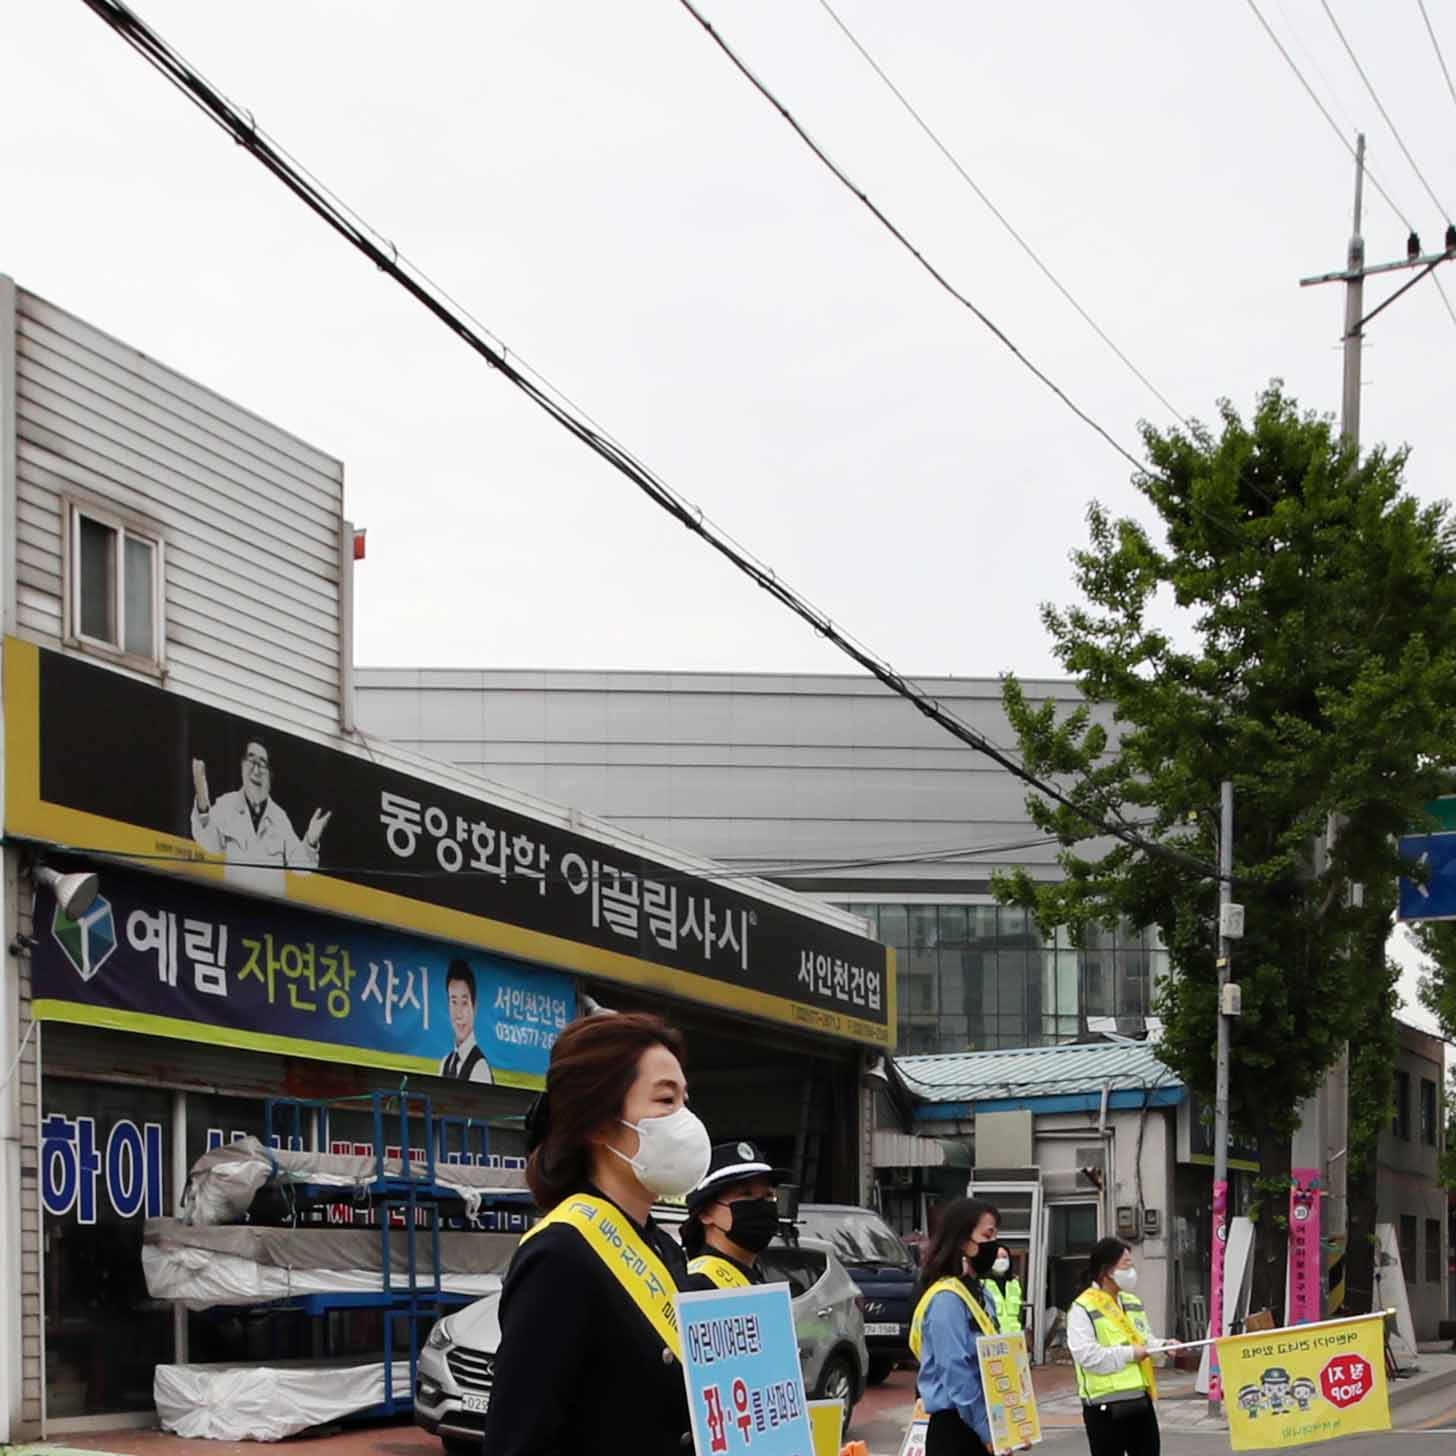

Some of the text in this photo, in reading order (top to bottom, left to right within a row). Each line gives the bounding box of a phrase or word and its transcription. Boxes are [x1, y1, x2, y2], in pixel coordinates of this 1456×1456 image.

[380, 791, 749, 970] 동양화학 이끌림샤시
[126, 909, 430, 1031] 예림 자연창 샤시
[495, 986, 567, 1029] 서인천건업
[797, 951, 881, 1010] 서인천건업
